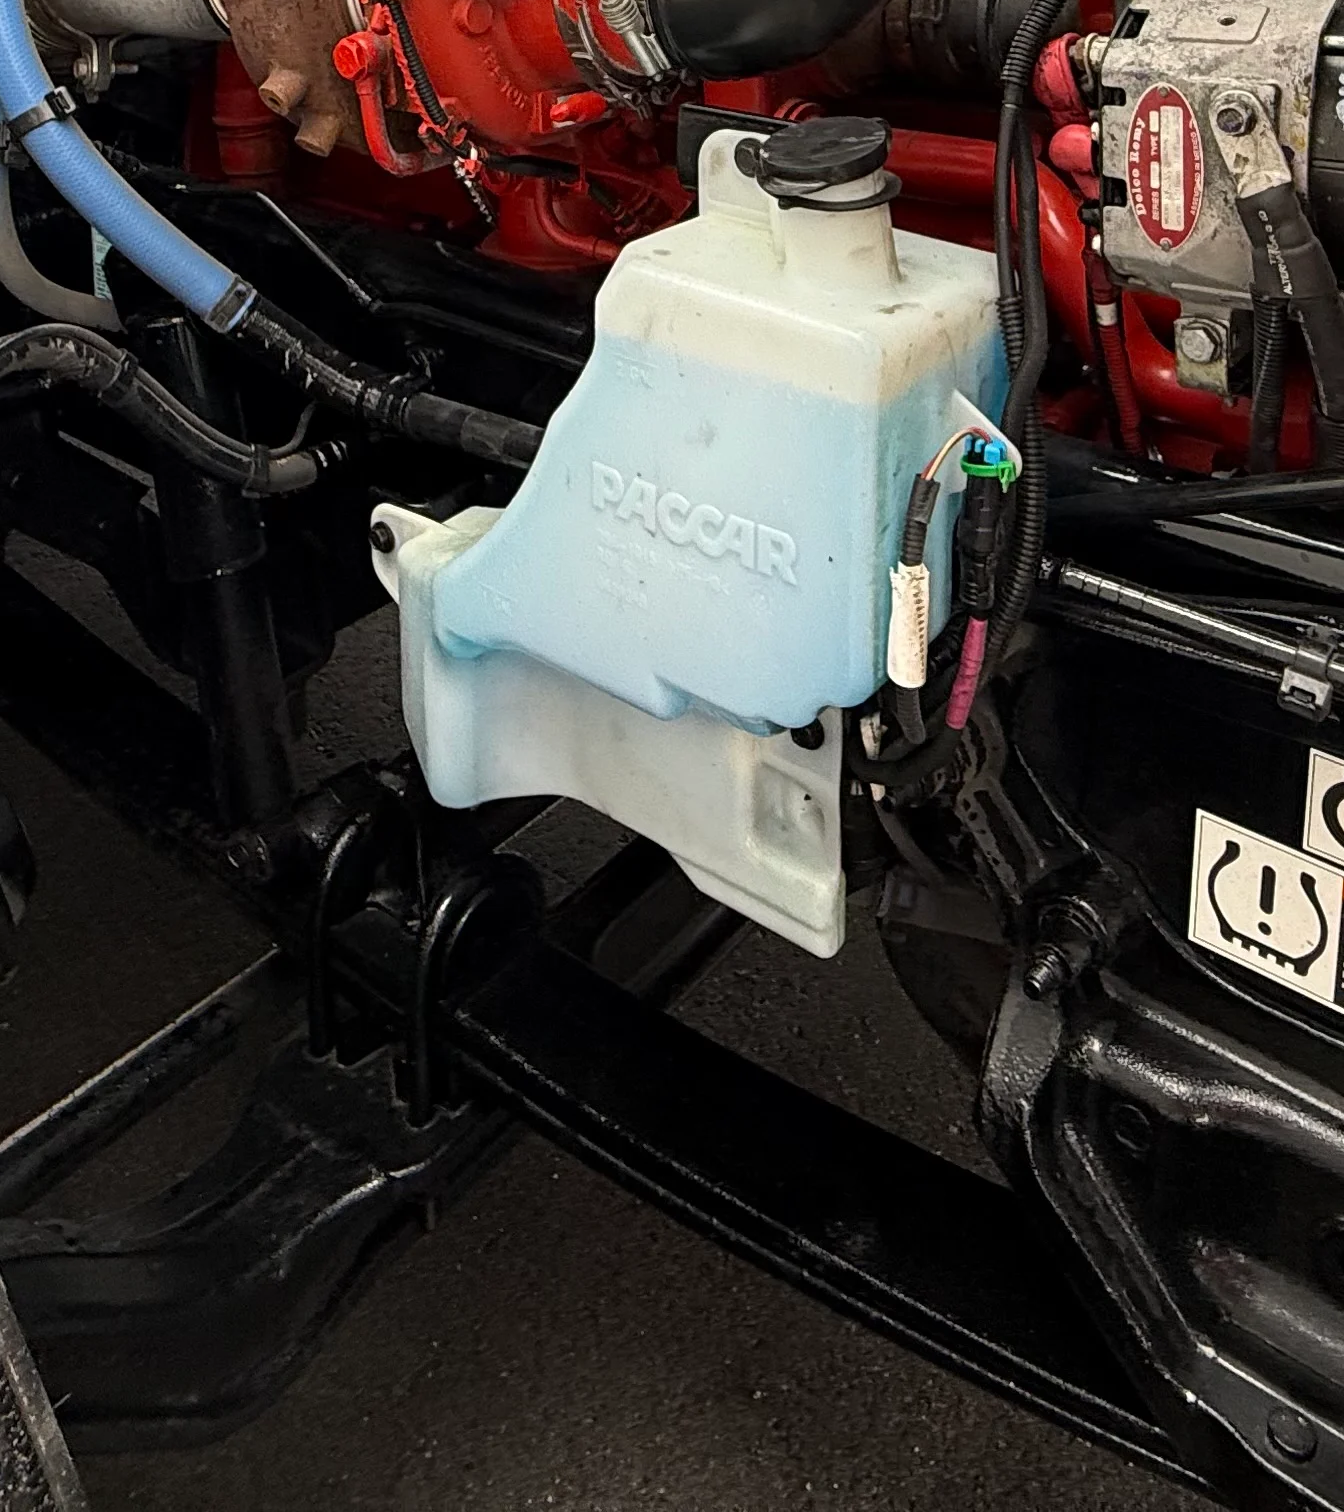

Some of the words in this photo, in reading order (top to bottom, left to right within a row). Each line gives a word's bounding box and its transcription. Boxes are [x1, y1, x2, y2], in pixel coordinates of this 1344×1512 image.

[1129, 117, 1146, 164] Remy
[1130, 168, 1147, 216] Delco
[591, 460, 797, 586] PACCAR
